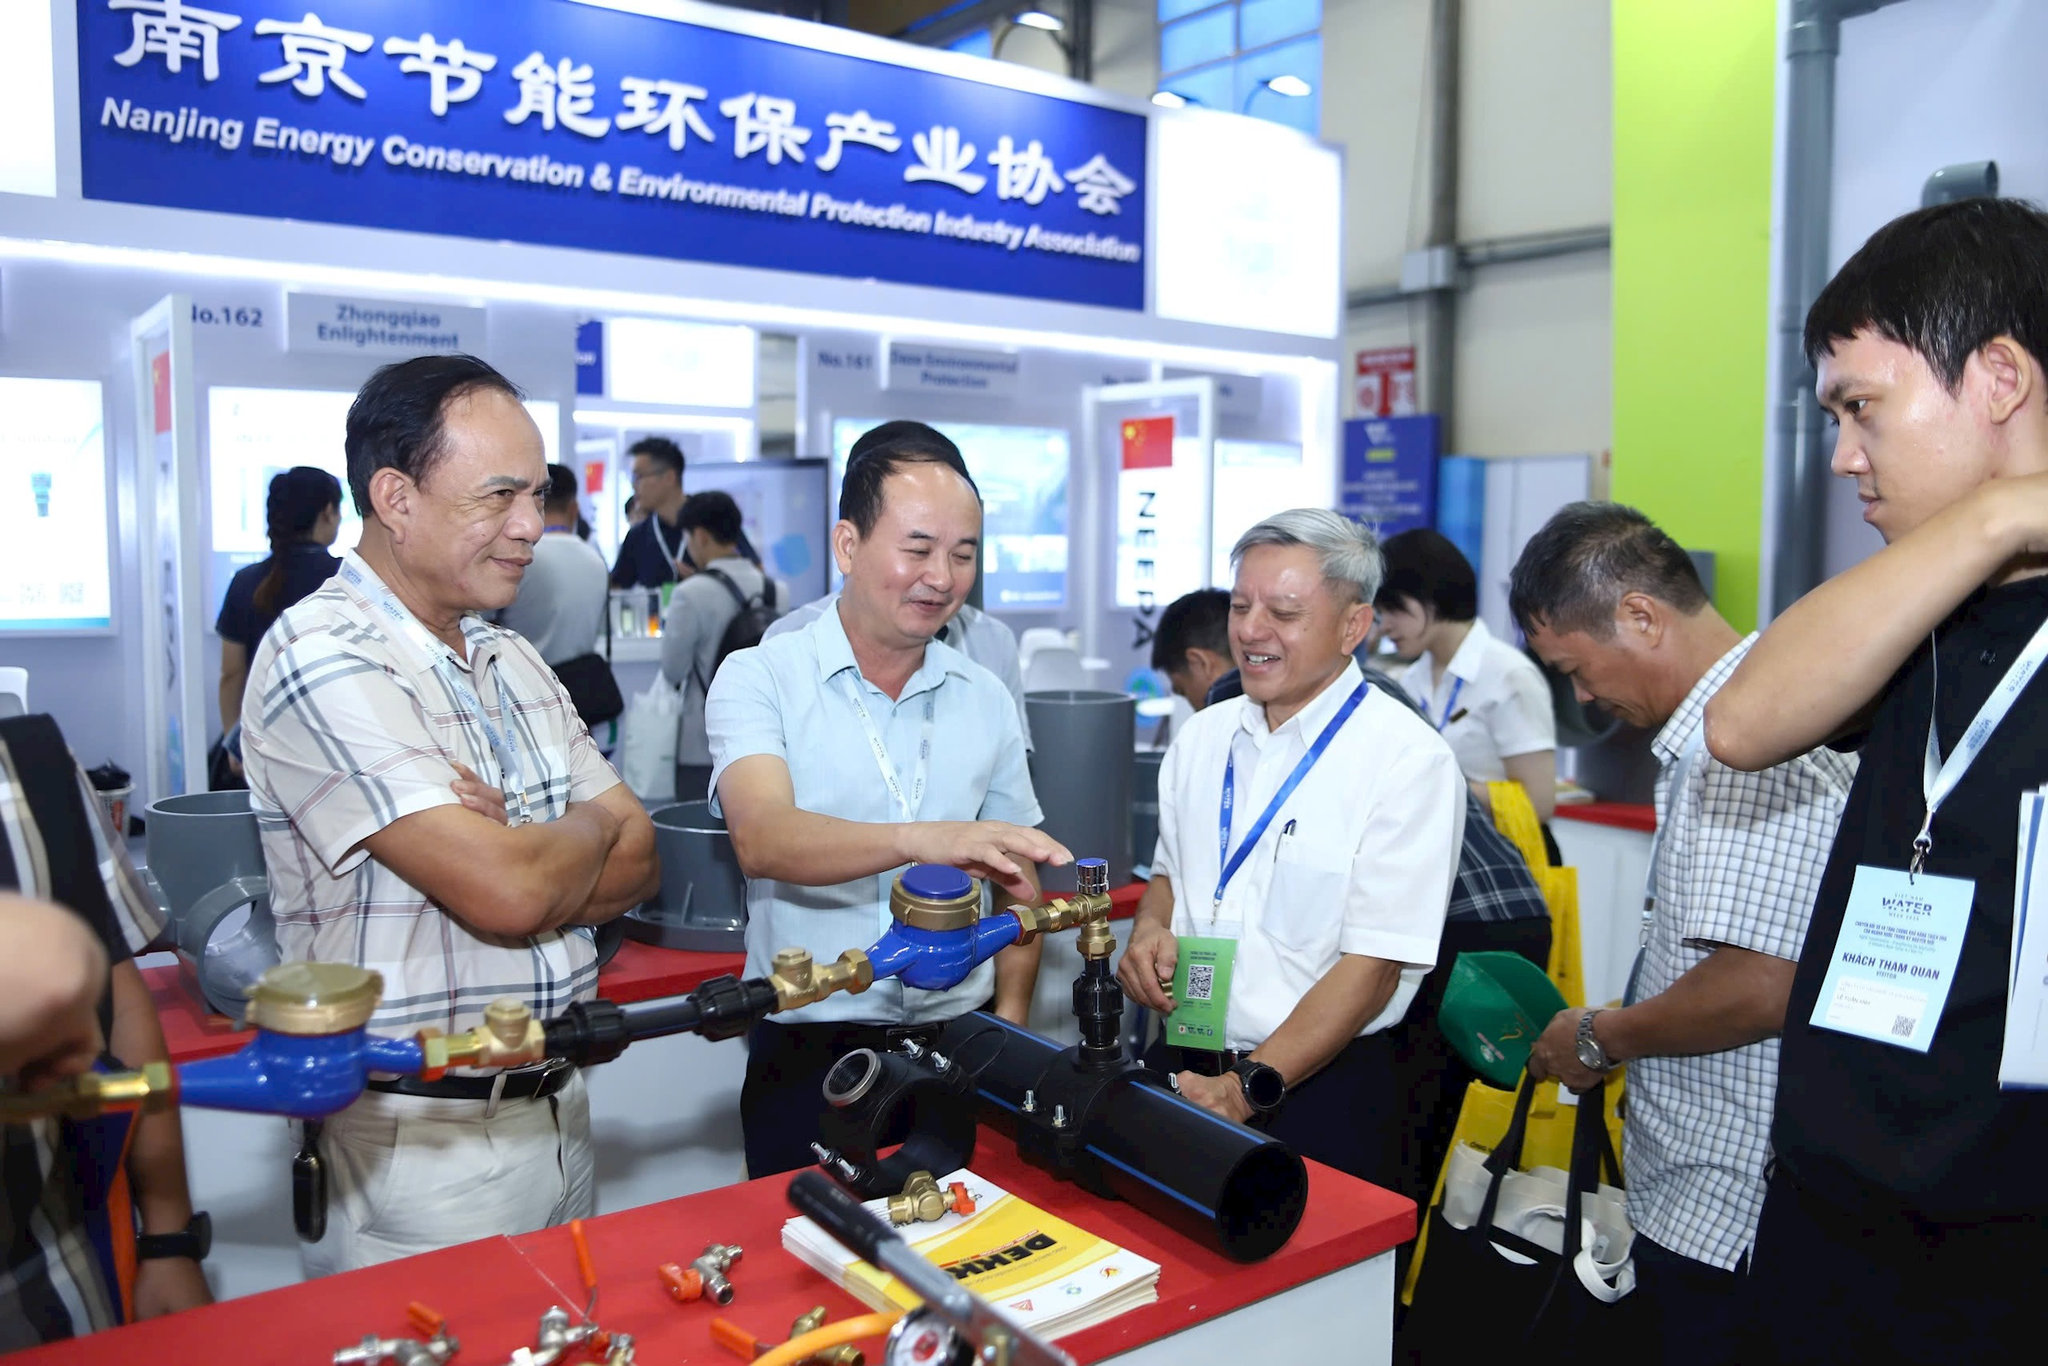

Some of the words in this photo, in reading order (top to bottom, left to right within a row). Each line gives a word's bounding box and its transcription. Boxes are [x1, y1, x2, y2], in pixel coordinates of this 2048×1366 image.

[110, 0, 1136, 215] 南京节能环保产业协会
[101, 96, 244, 150] Nanjing
[253, 117, 374, 167] Energy
[382, 135, 584, 190] Conservation
[591, 162, 612, 190] &
[619, 167, 806, 217] Environmental
[811, 193, 932, 234] Protection
[934, 212, 1025, 251] Industry
[1025, 224, 1141, 262] Association
[335, 304, 441, 330] Zhongqiao
[317, 323, 460, 349] Enlightenment
[1882, 897, 1933, 917] WATER
[1842, 951, 1876, 967] KHÁCH
[1879, 958, 1908, 974] THAM
[1910, 965, 1941, 980] QUAN
[943, 1232, 1058, 1280] DEKK
